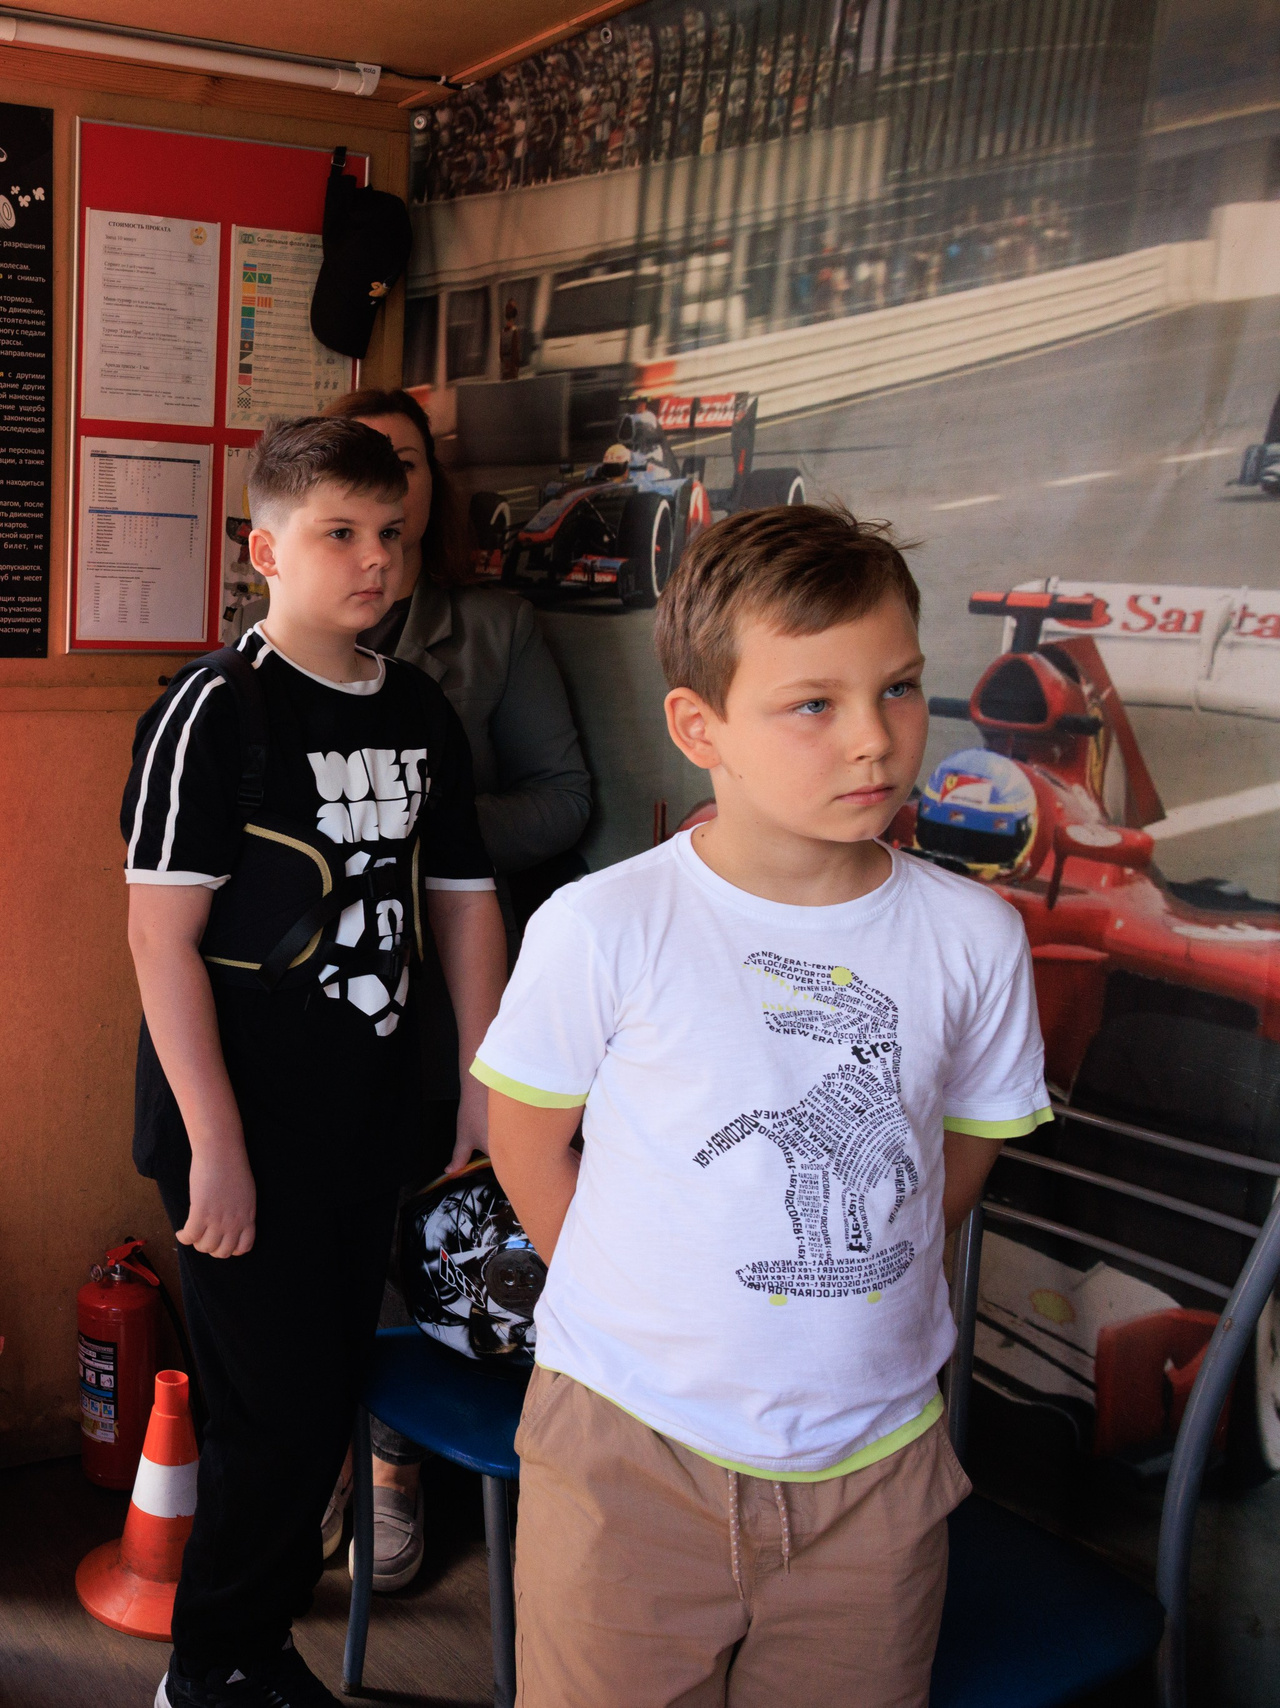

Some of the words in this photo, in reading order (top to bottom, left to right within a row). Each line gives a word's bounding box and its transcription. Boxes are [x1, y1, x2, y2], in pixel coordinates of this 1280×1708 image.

[108, 221, 145, 230] СТОИМОСТЬ
[145, 224, 172, 233] ПРОКАТА
[4, 240, 45, 252] разрешения
[0, 261, 30, 270] колесам.
[17, 274, 46, 283] снимать
[4, 294, 33, 305] тормоза.
[16, 372, 45, 382] другими
[4, 414, 45, 423] закончиться
[9, 447, 44, 456] персонала
[6, 479, 44, 488] находиться
[761, 951, 782, 961] NEW
[784, 957, 801, 966] ERA
[804, 961, 826, 970] t-rex
[752, 959, 815, 978] VELOCIRAPTOR
[764, 966, 813, 984] DISCOVER
[846, 983, 890, 1011] DISCOVER
[834, 992, 860, 1005] DISCOVER
[863, 984, 884, 997] t-rex
[884, 995, 898, 1013] NEW
[783, 1020, 813, 1030] DISCOVER
[833, 1031, 867, 1040] DISCOVER
[783, 1027, 809, 1037] NEW
[812, 1033, 834, 1045] ERA
[851, 1040, 899, 1065] t-rex
